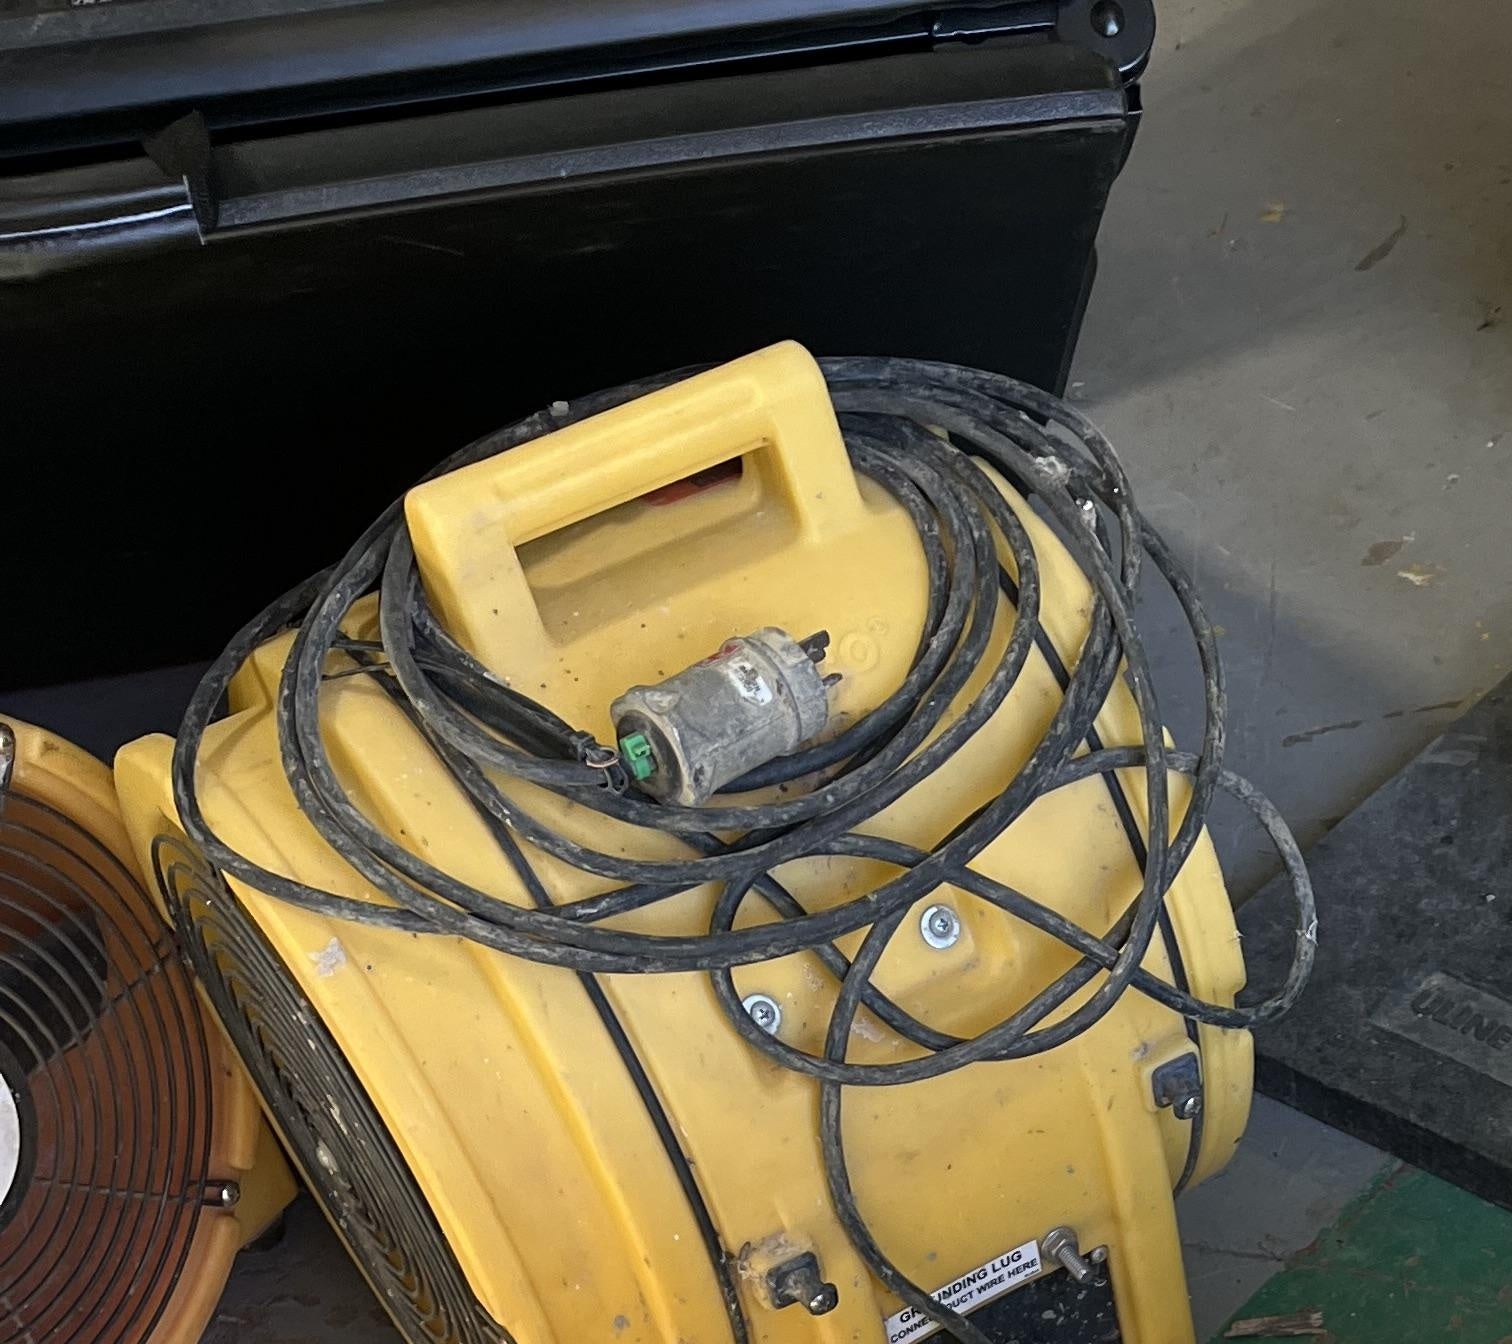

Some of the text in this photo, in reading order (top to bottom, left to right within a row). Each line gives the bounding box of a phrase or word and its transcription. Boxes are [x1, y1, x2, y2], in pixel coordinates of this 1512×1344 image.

[991, 1250, 1022, 1273] LUG
[890, 1316, 933, 1344] CONNE
[976, 1274, 1005, 1295] WIRE
[1007, 1257, 1038, 1279] HERE
